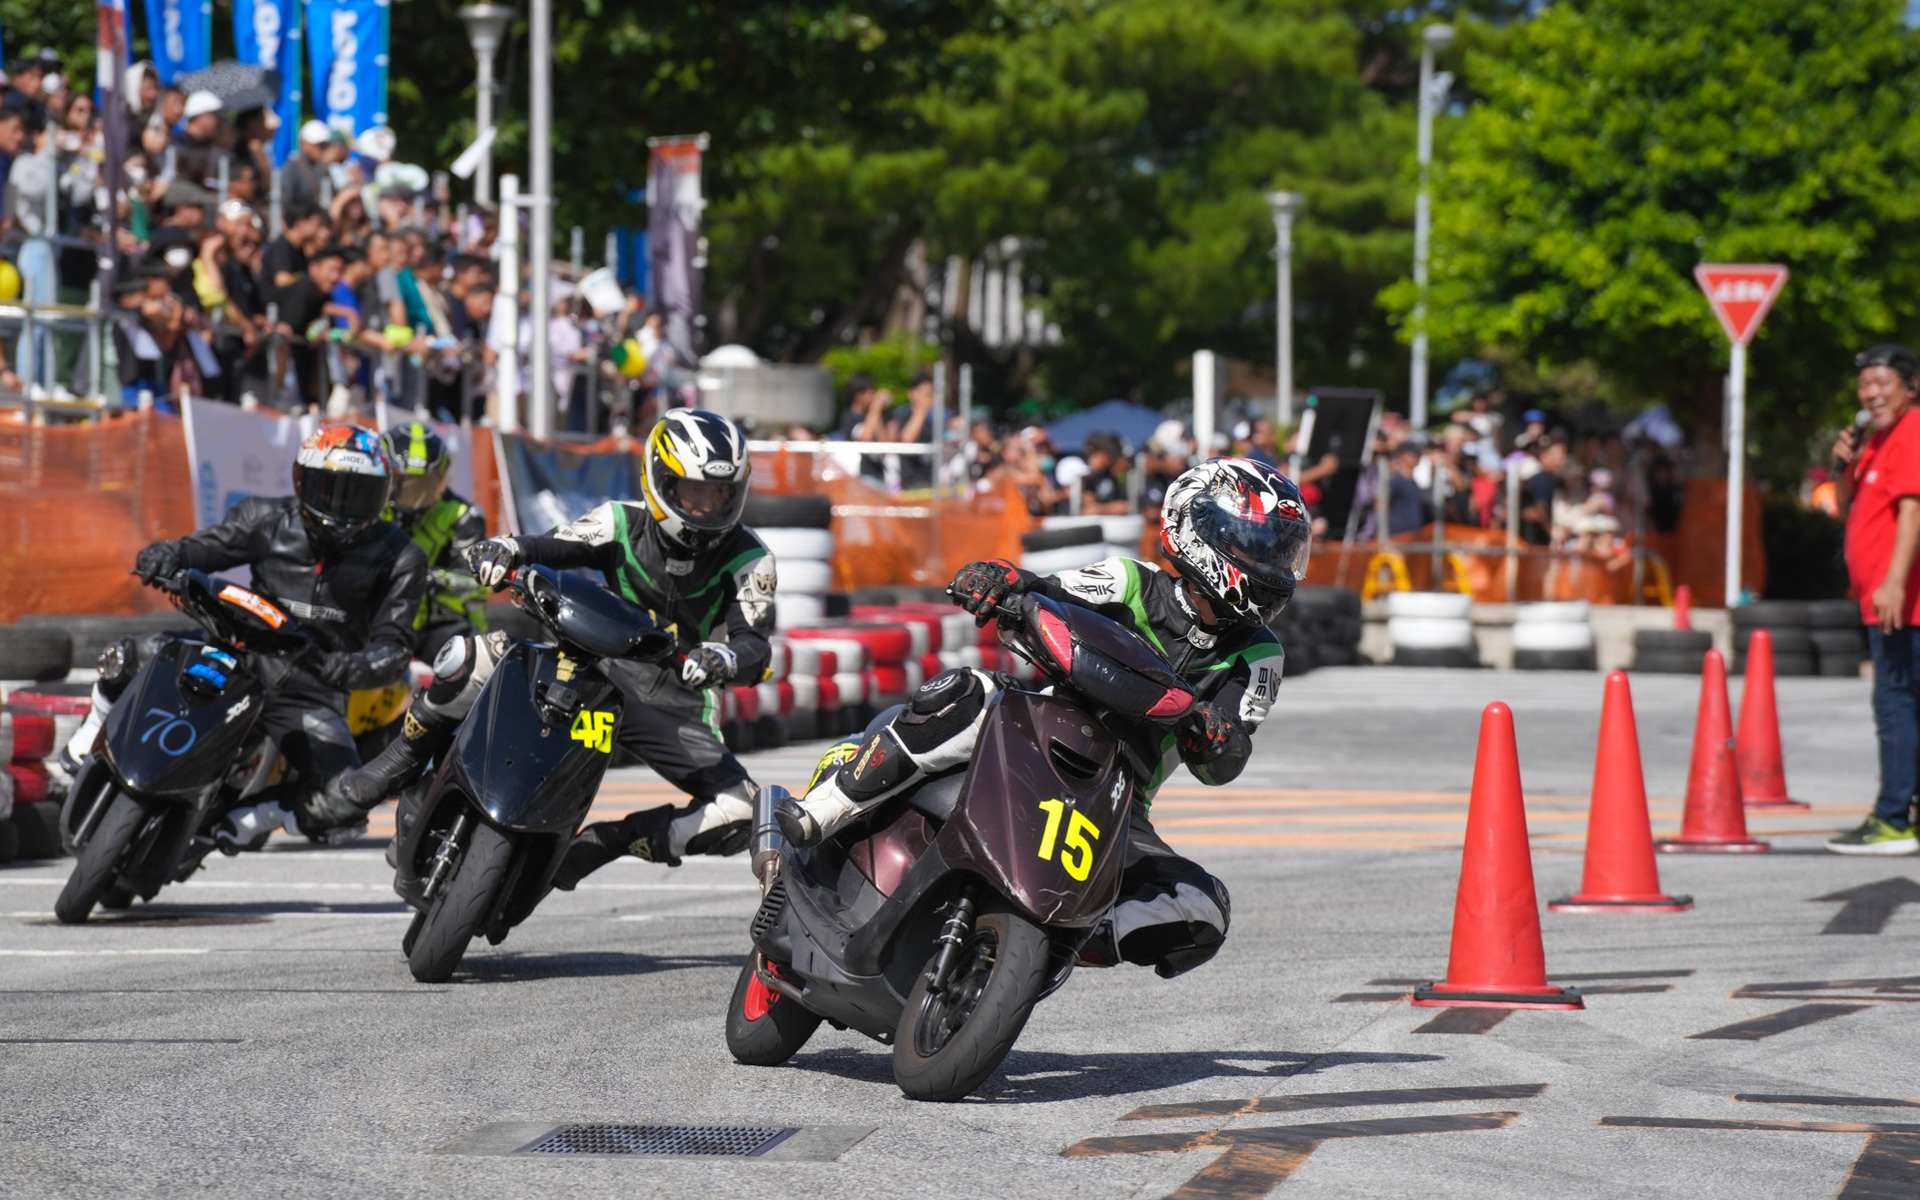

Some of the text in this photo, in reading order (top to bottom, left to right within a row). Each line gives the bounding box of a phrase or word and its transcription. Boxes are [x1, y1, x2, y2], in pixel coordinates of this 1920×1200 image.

[1069, 583, 1116, 596] ERIK
[141, 707, 197, 756] 70
[571, 710, 614, 753] 46
[1038, 798, 1100, 881] 15
